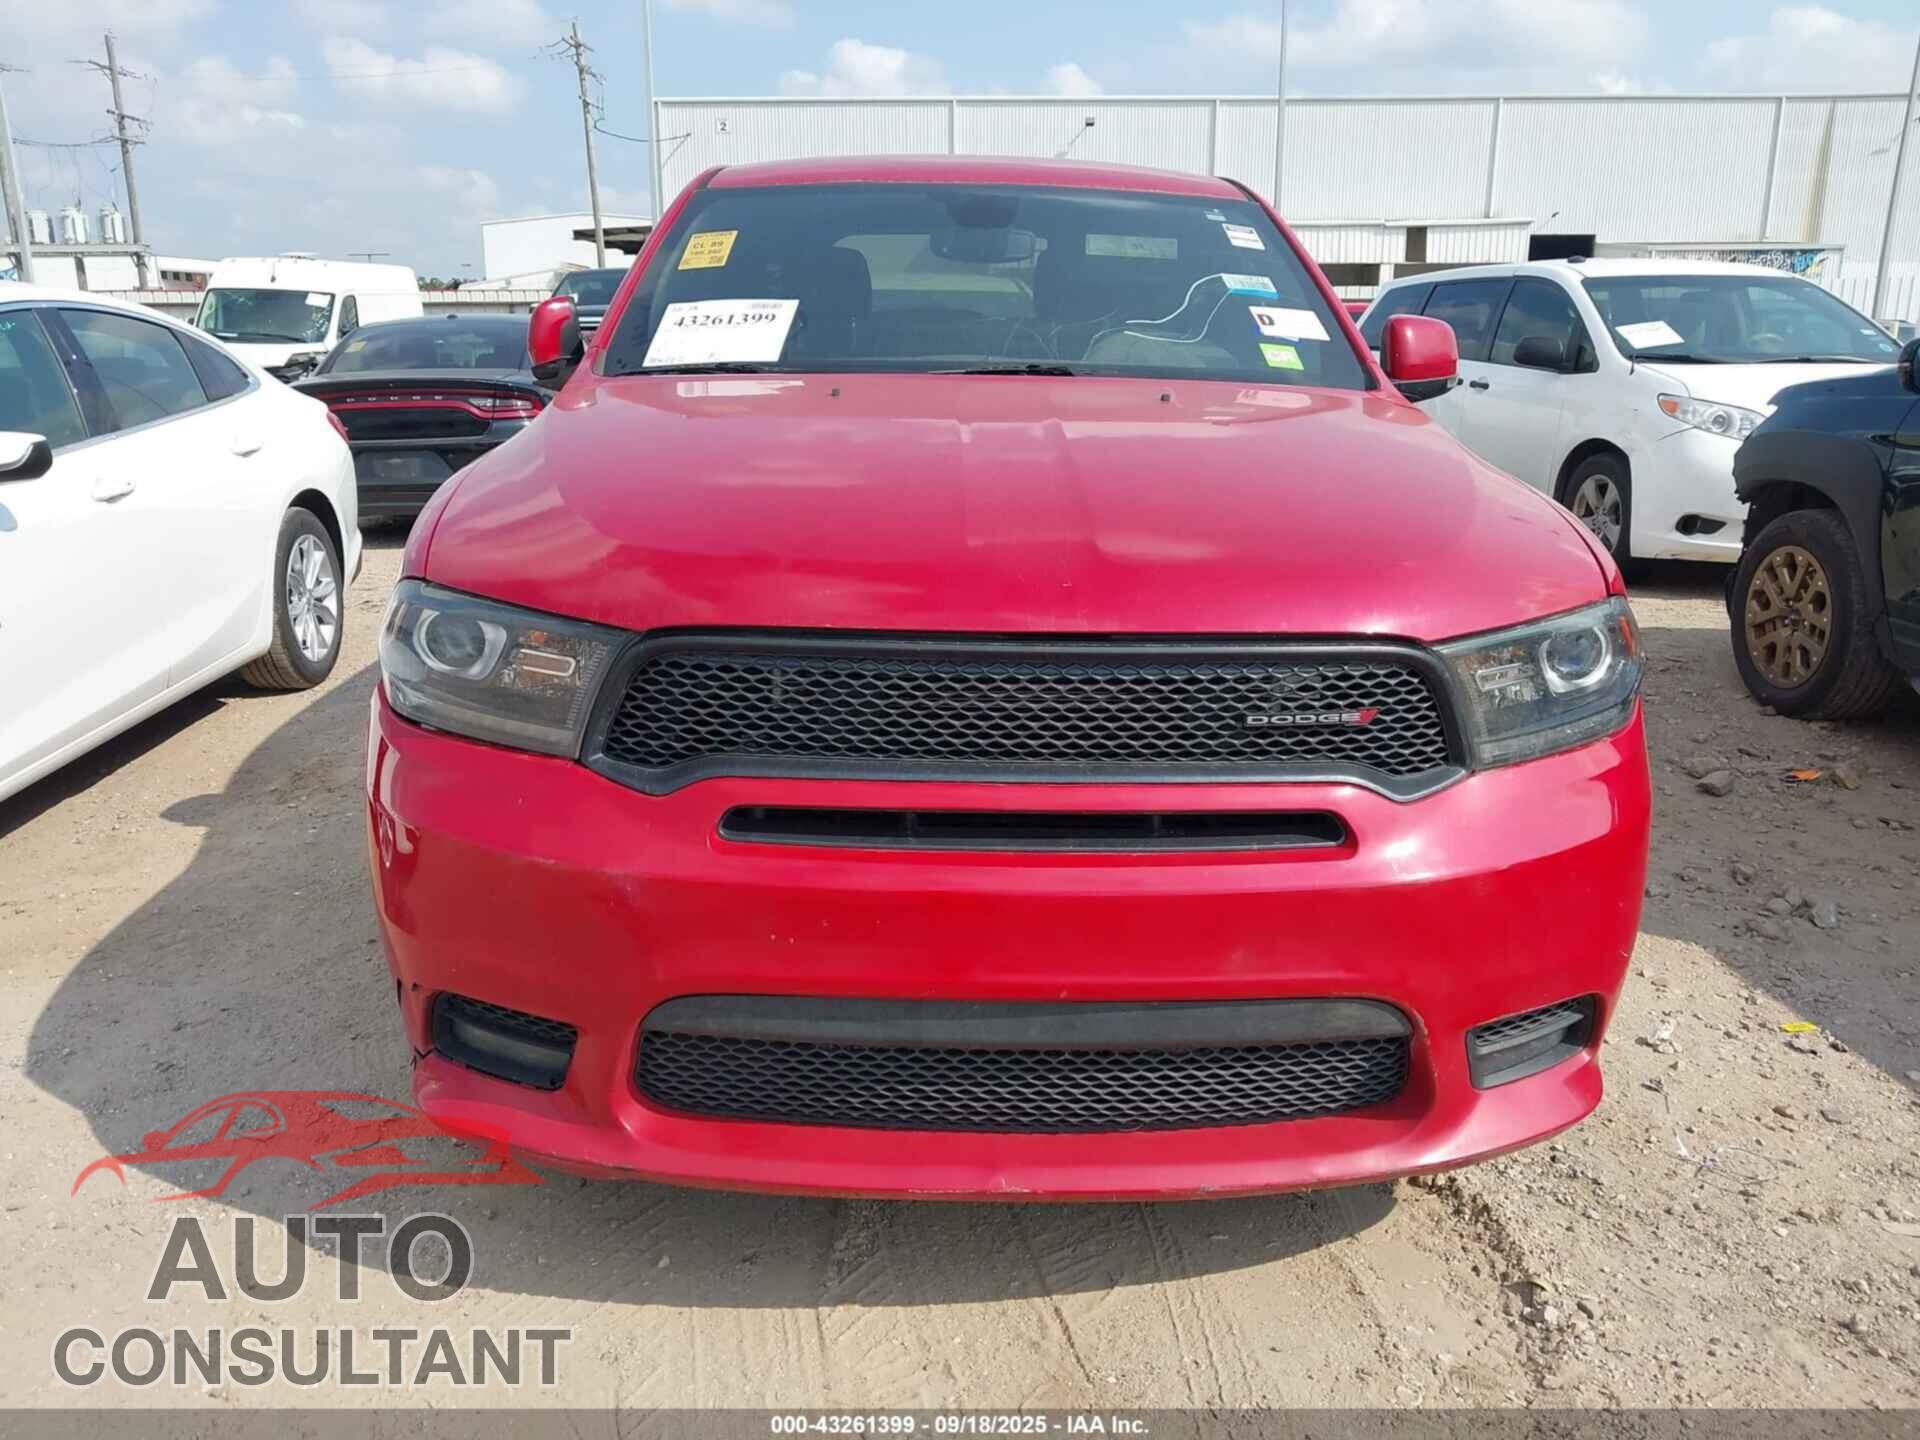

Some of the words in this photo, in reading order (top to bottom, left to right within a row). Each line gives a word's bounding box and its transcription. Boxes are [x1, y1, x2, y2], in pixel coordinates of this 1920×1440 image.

[719, 121, 727, 131] 2
[673, 312, 776, 327] 43261399
[1257, 313, 1275, 326] D
[1246, 712, 1361, 724] DODGE
